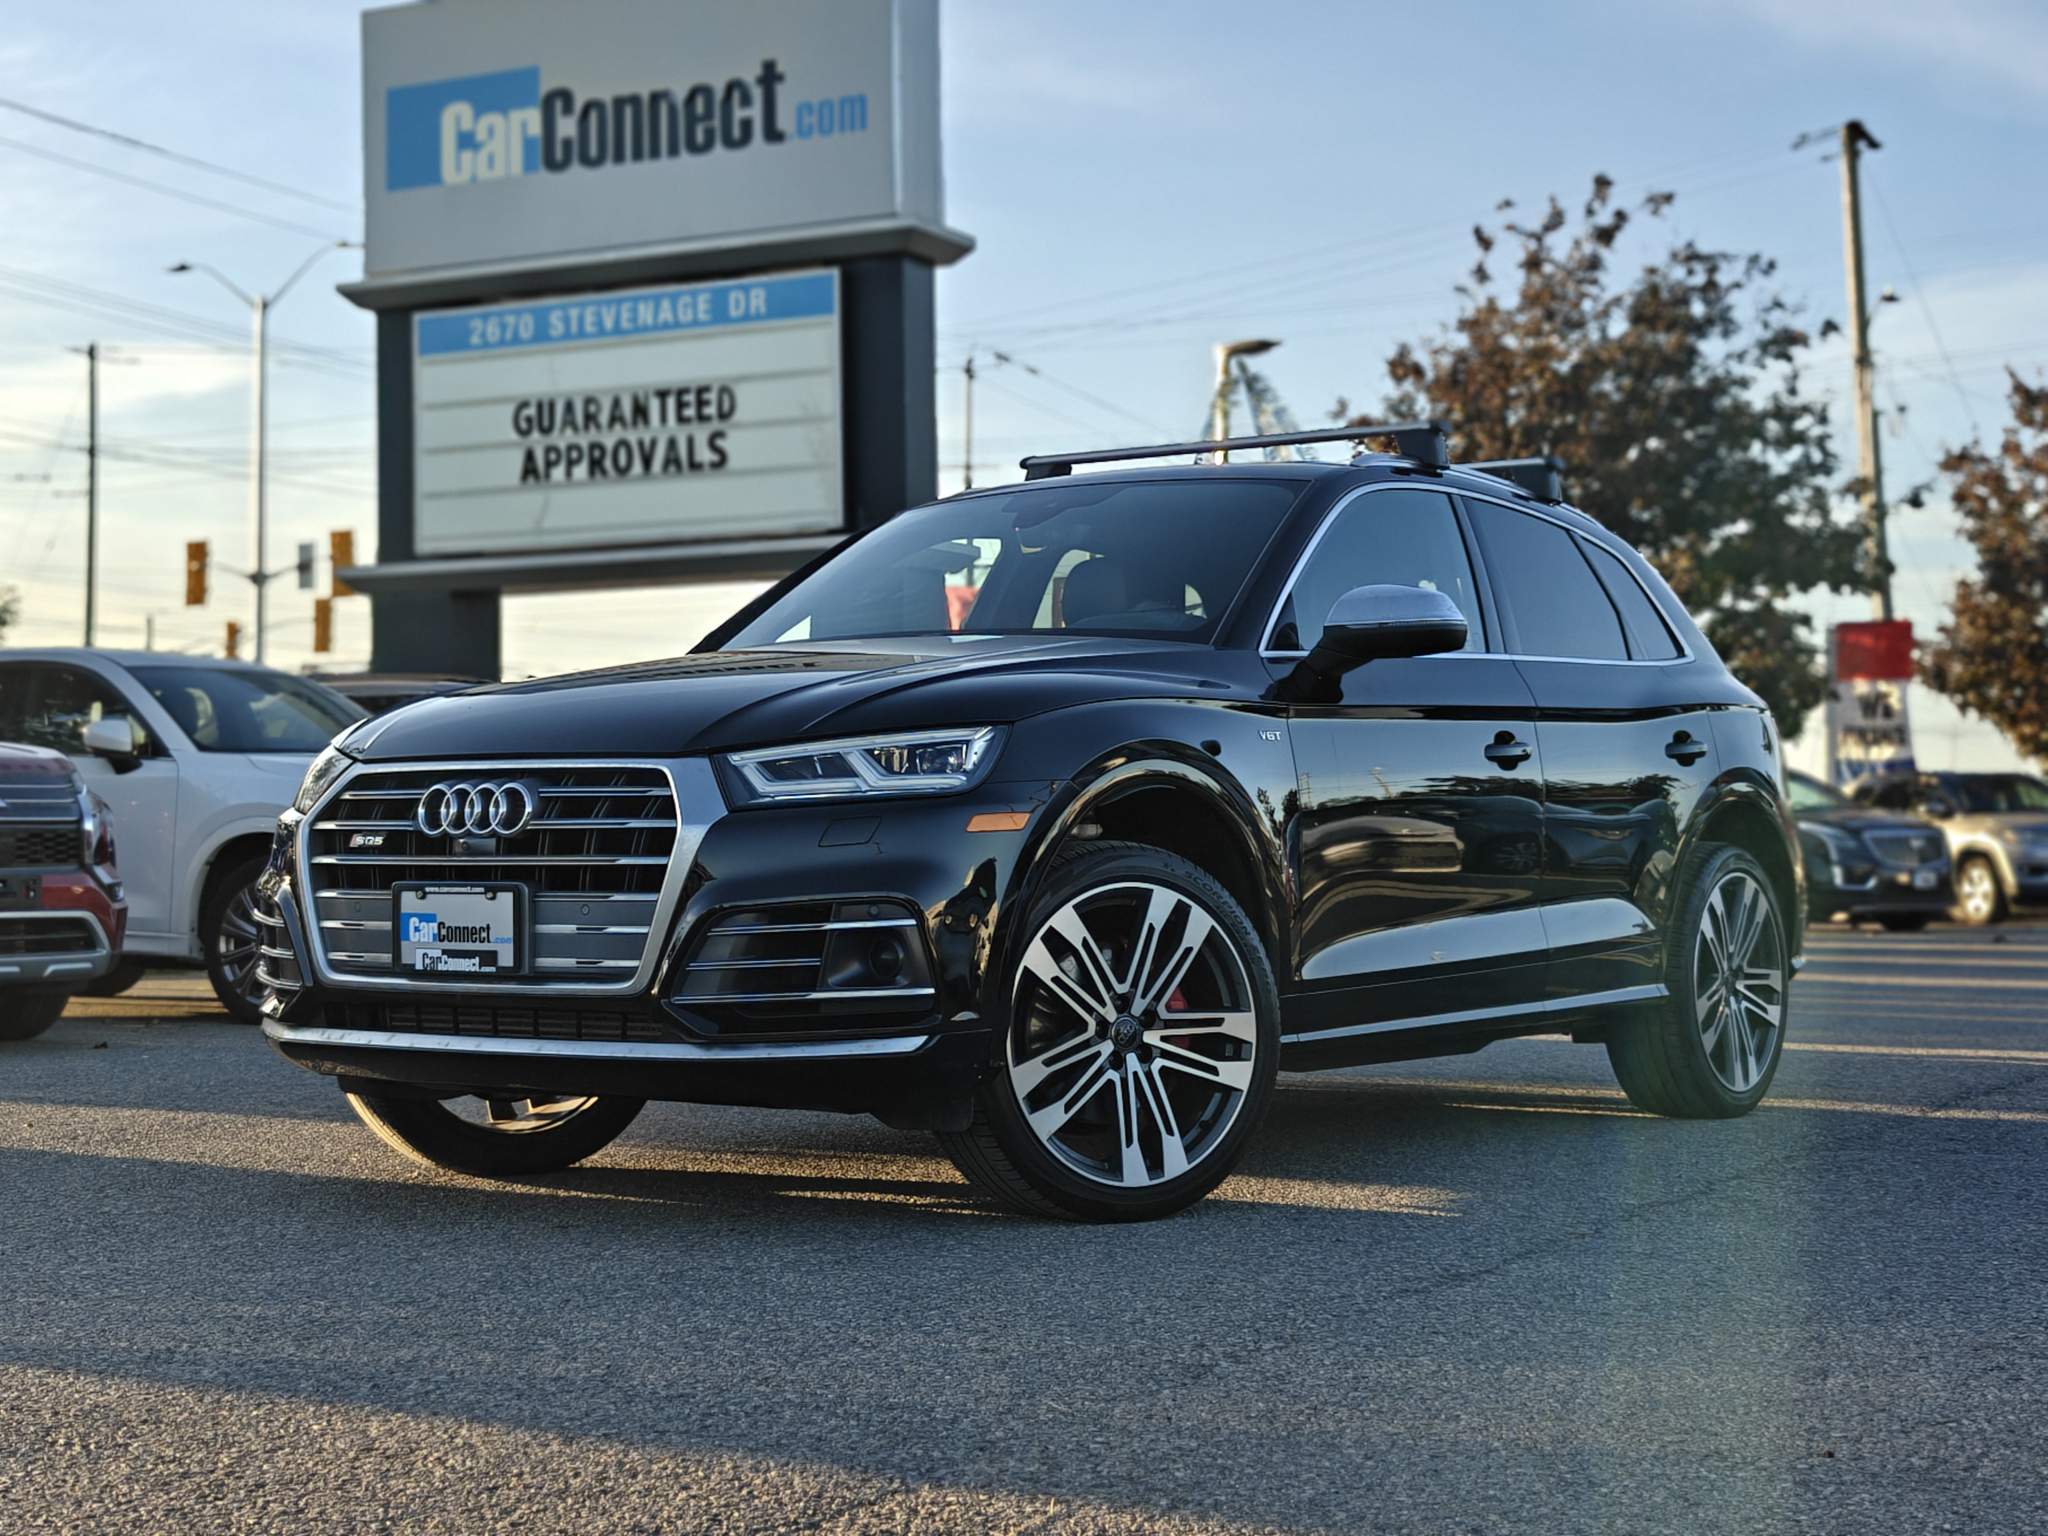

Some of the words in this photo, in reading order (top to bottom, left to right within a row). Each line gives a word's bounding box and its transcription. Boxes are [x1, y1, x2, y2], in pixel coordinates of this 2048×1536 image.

[440, 59, 868, 186] CarConnect.com
[469, 313, 534, 345] 2670
[548, 291, 712, 339] STEVENAGE
[728, 287, 767, 318] DR
[513, 383, 737, 438] GUARANTEED
[520, 431, 729, 485] APPROVALS
[1259, 731, 1281, 741] V6T
[355, 835, 385, 846] SQ5
[409, 917, 513, 944] CarConnect.com
